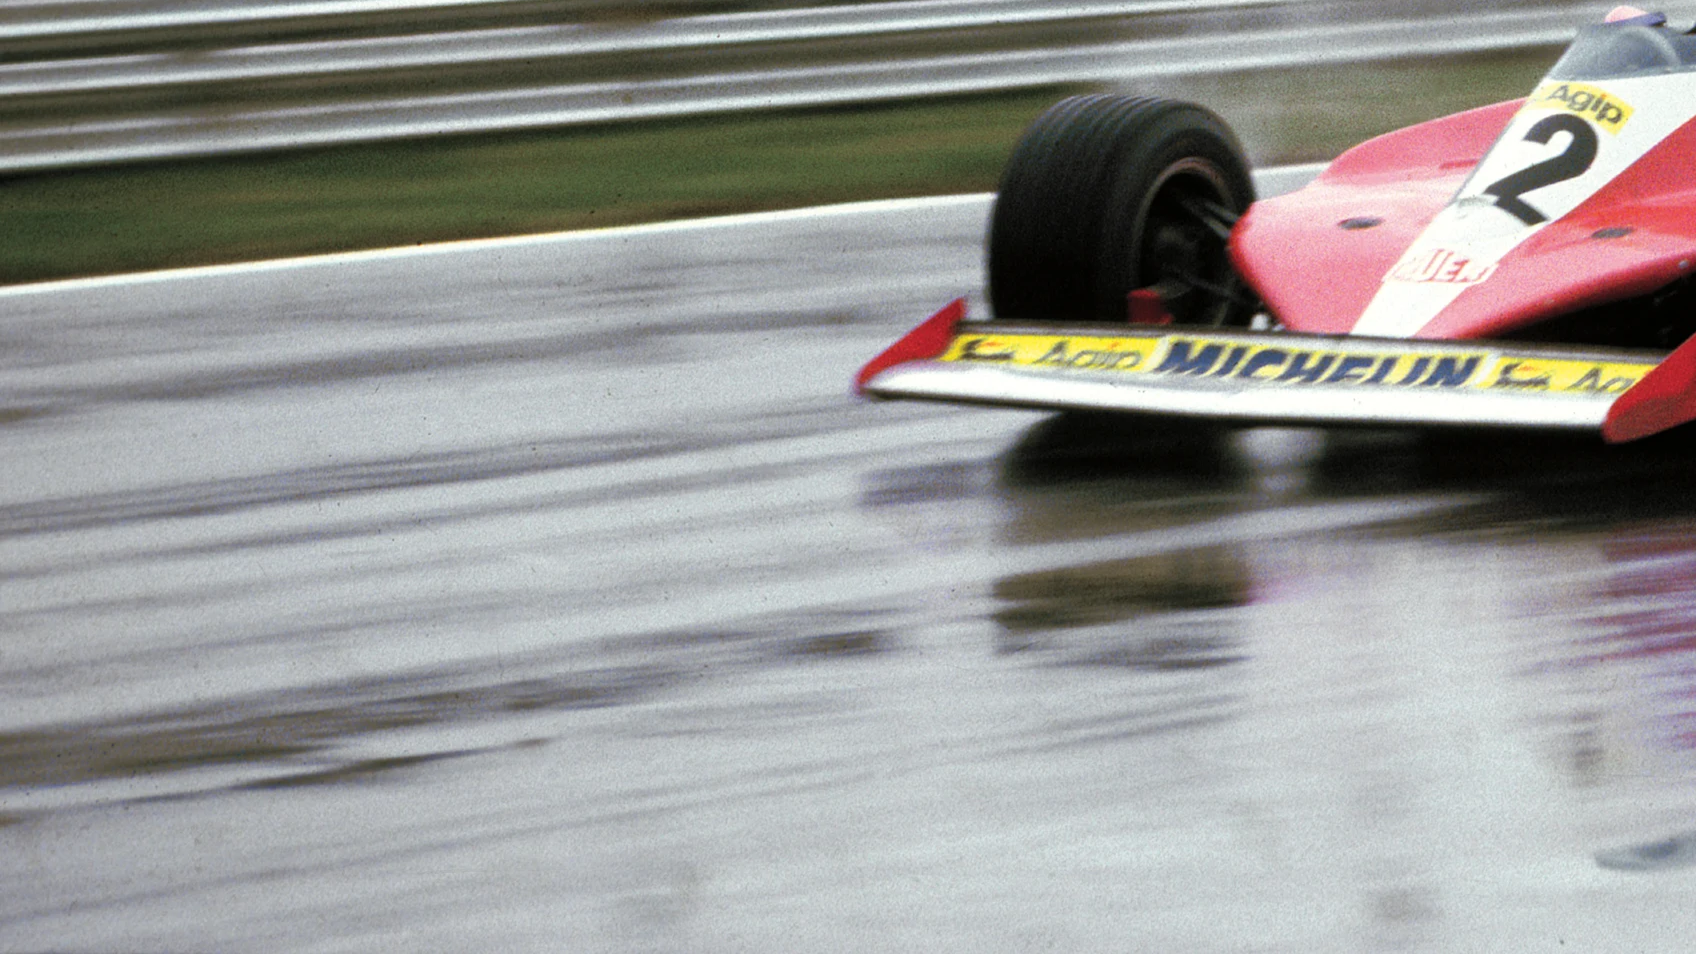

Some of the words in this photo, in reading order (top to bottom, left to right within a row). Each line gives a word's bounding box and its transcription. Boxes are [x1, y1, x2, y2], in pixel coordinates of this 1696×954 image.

[1545, 84, 1623, 123] Agip
[1483, 113, 1599, 227] 2
[1153, 342, 1481, 387] MICHELIN
[1563, 365, 1638, 392] Ag
